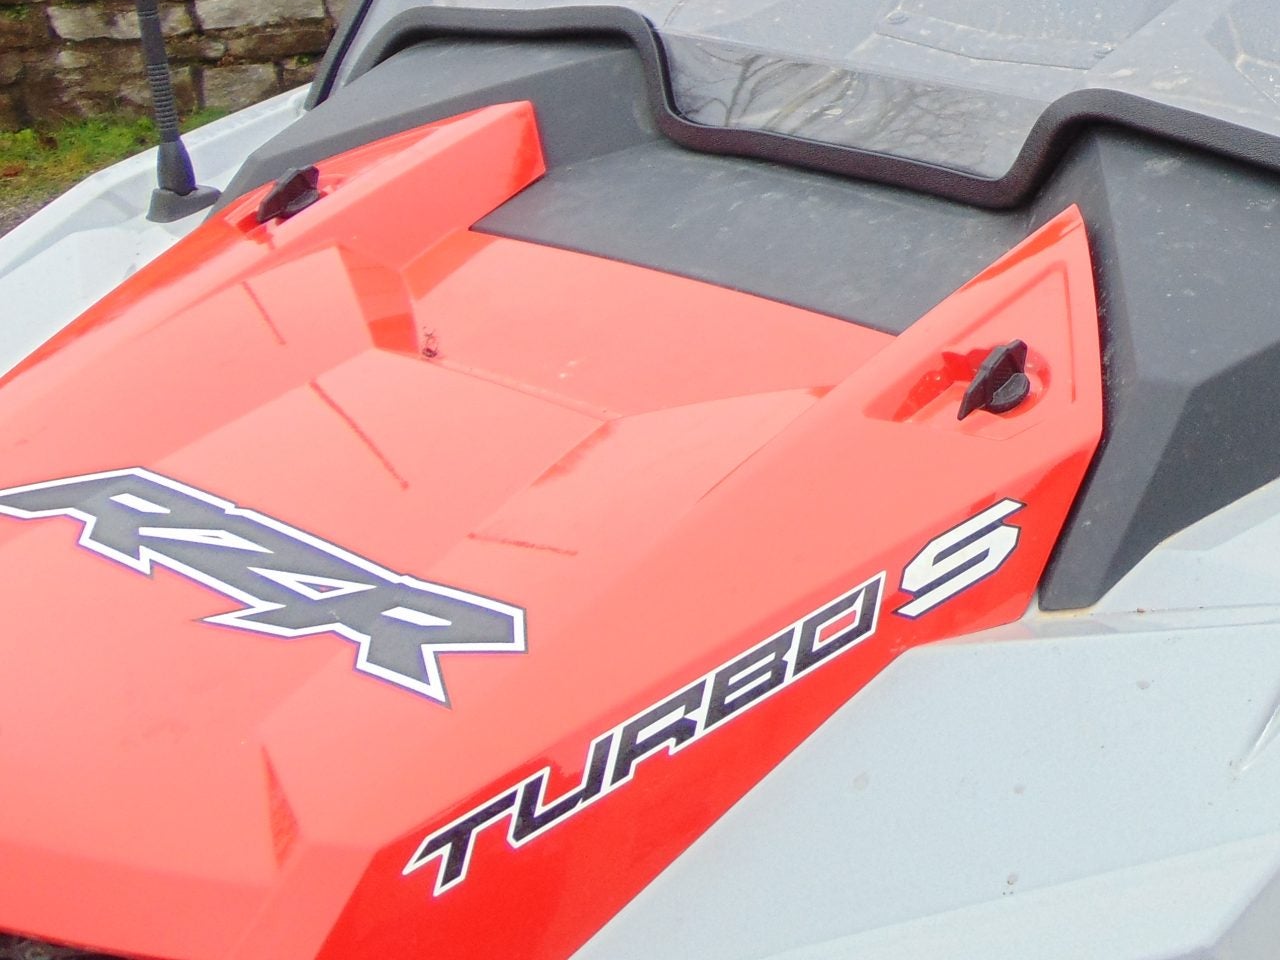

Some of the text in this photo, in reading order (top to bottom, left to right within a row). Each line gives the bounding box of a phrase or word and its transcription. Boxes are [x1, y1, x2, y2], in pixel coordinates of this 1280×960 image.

[0, 467, 528, 709] RZR
[402, 496, 1028, 897] TURBO S
